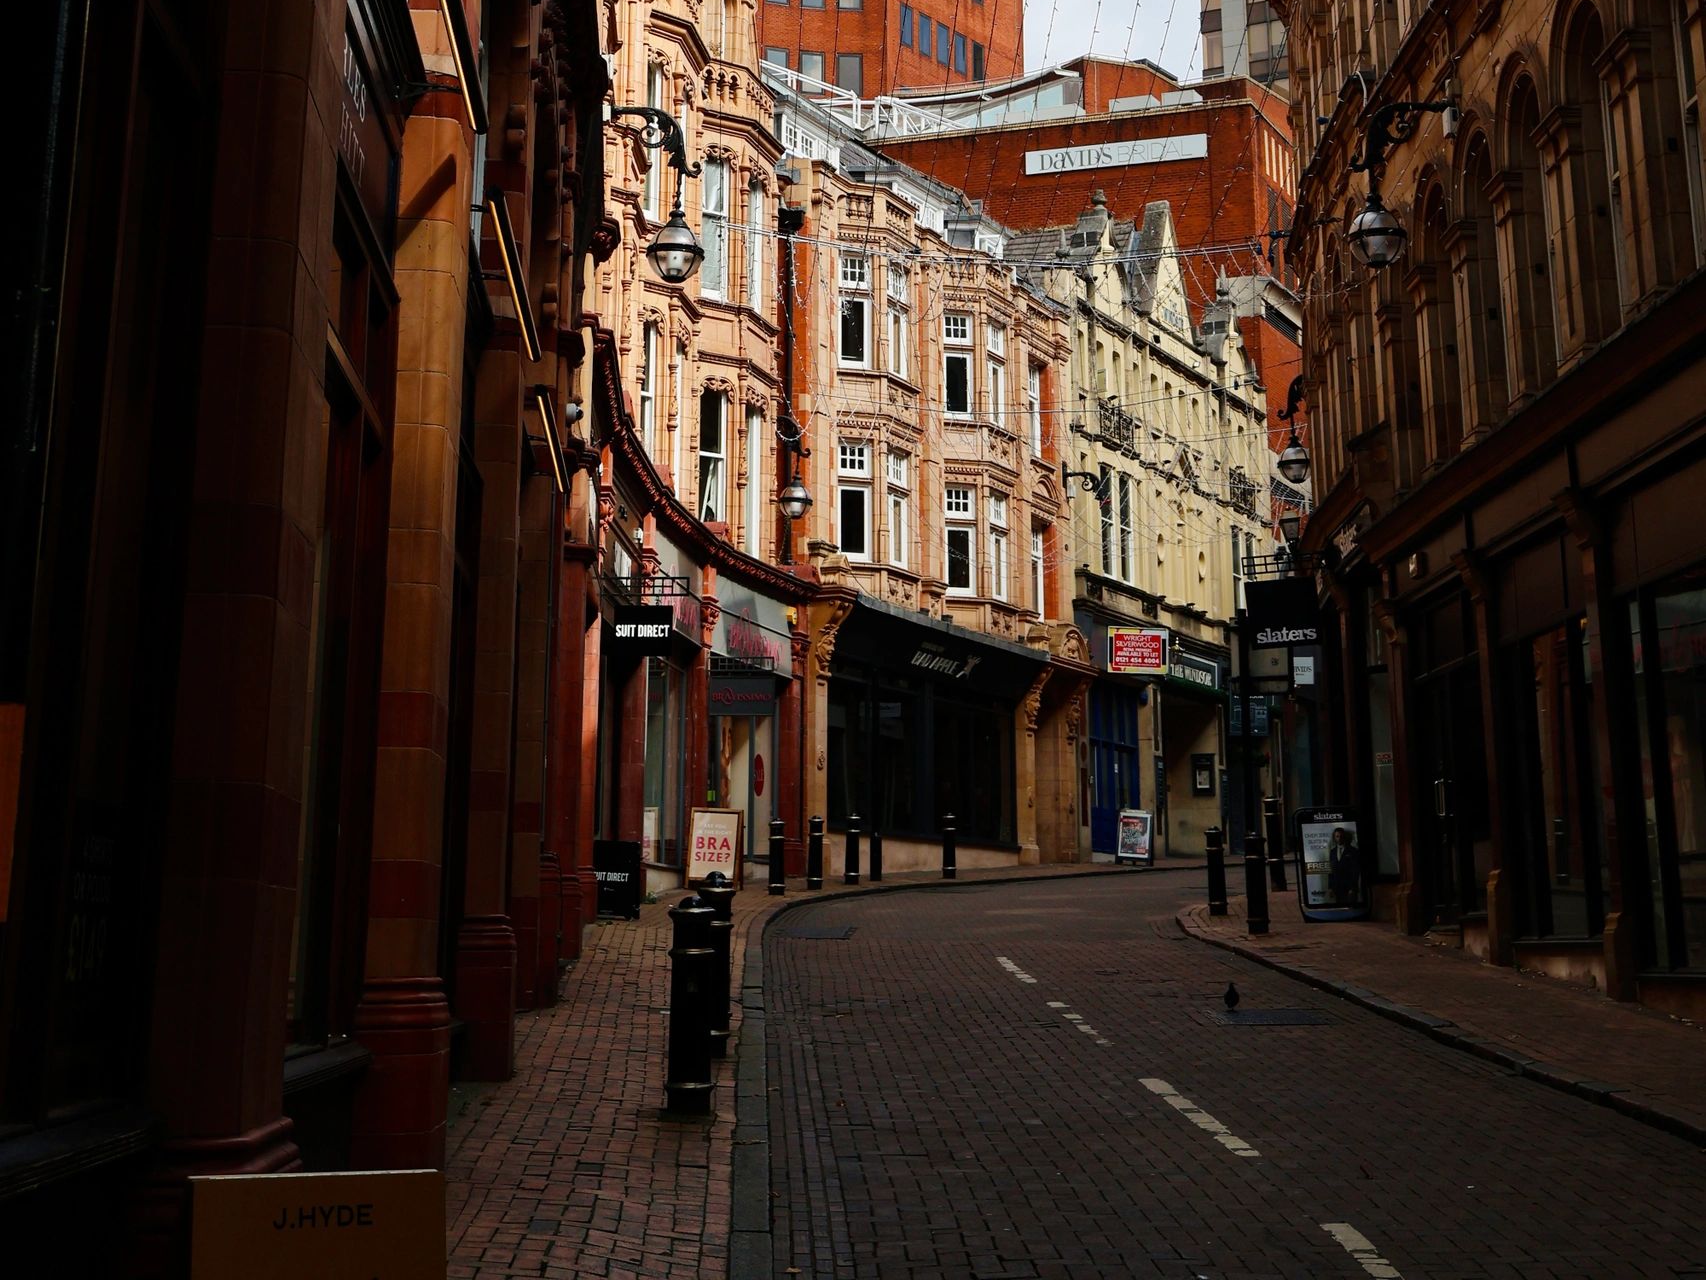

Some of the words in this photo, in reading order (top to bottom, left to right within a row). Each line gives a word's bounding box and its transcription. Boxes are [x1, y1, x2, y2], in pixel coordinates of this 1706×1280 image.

[1117, 139, 1193, 163] BRIDAL
[615, 624, 636, 638] SUIT
[638, 624, 670, 638] DIRECT
[1256, 626, 1318, 644] slaters
[1313, 811, 1344, 820] slaters
[695, 836, 731, 850] BRA
[694, 851, 731, 863] SIZE?
[606, 872, 629, 883] DIRECT
[273, 1204, 374, 1230] J.HYDE
